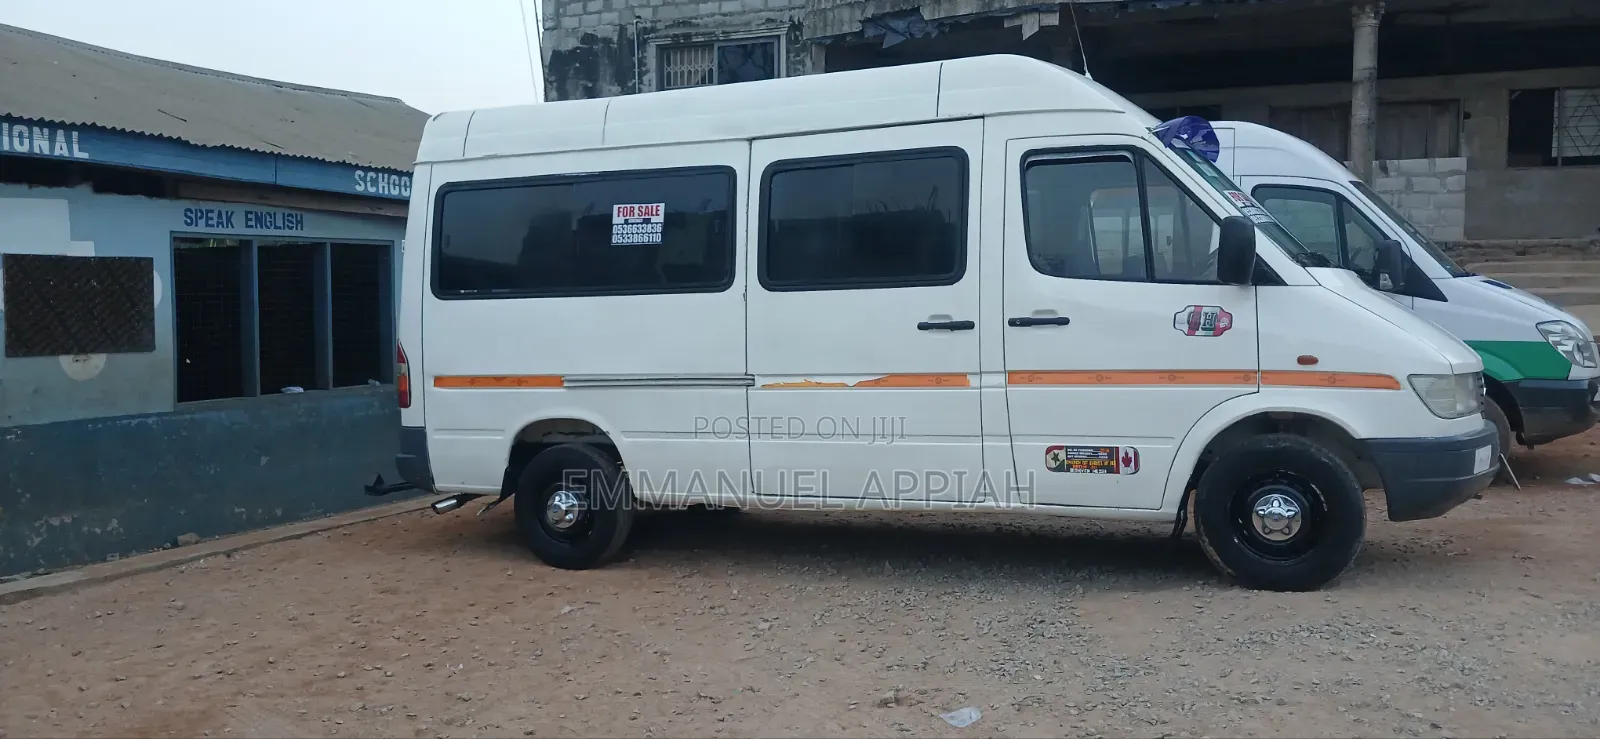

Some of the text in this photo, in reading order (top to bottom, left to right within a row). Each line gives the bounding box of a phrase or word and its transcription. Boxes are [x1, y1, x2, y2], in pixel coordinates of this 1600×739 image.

[617, 205, 660, 218] FOR SALE
[183, 207, 304, 231] SPEAK ENGLISH
[612, 223, 662, 234] 0536633836
[612, 233, 662, 243] 0533866110
